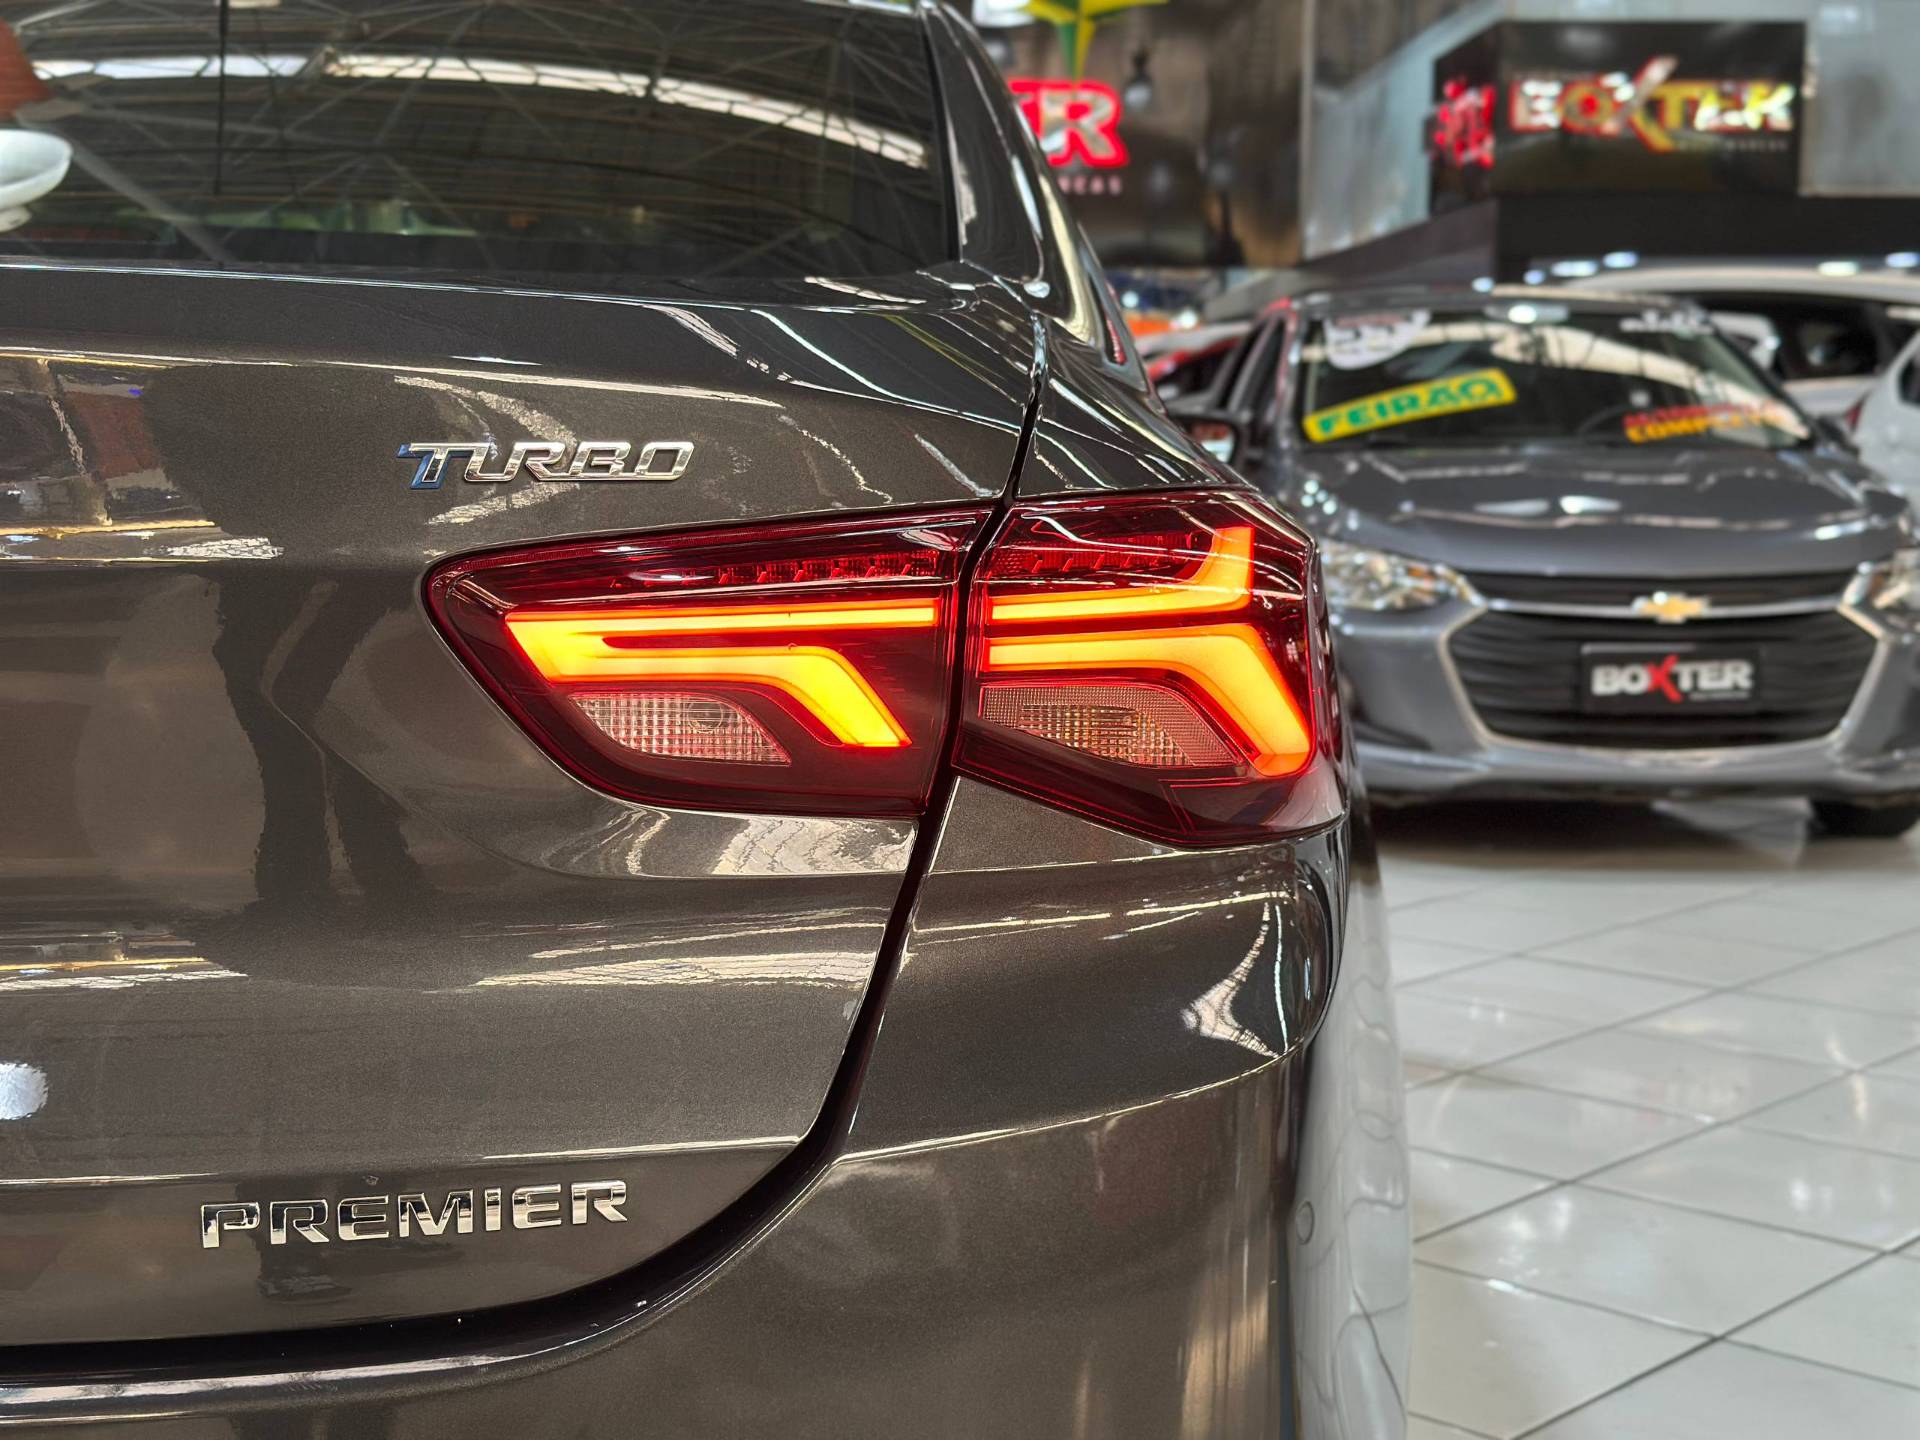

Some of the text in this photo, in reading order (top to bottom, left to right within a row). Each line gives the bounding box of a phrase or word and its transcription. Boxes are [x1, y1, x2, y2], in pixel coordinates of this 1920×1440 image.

[397, 441, 695, 489] TURBO
[1591, 654, 1754, 703] BOXTER
[200, 1179, 628, 1249] PREMIER
